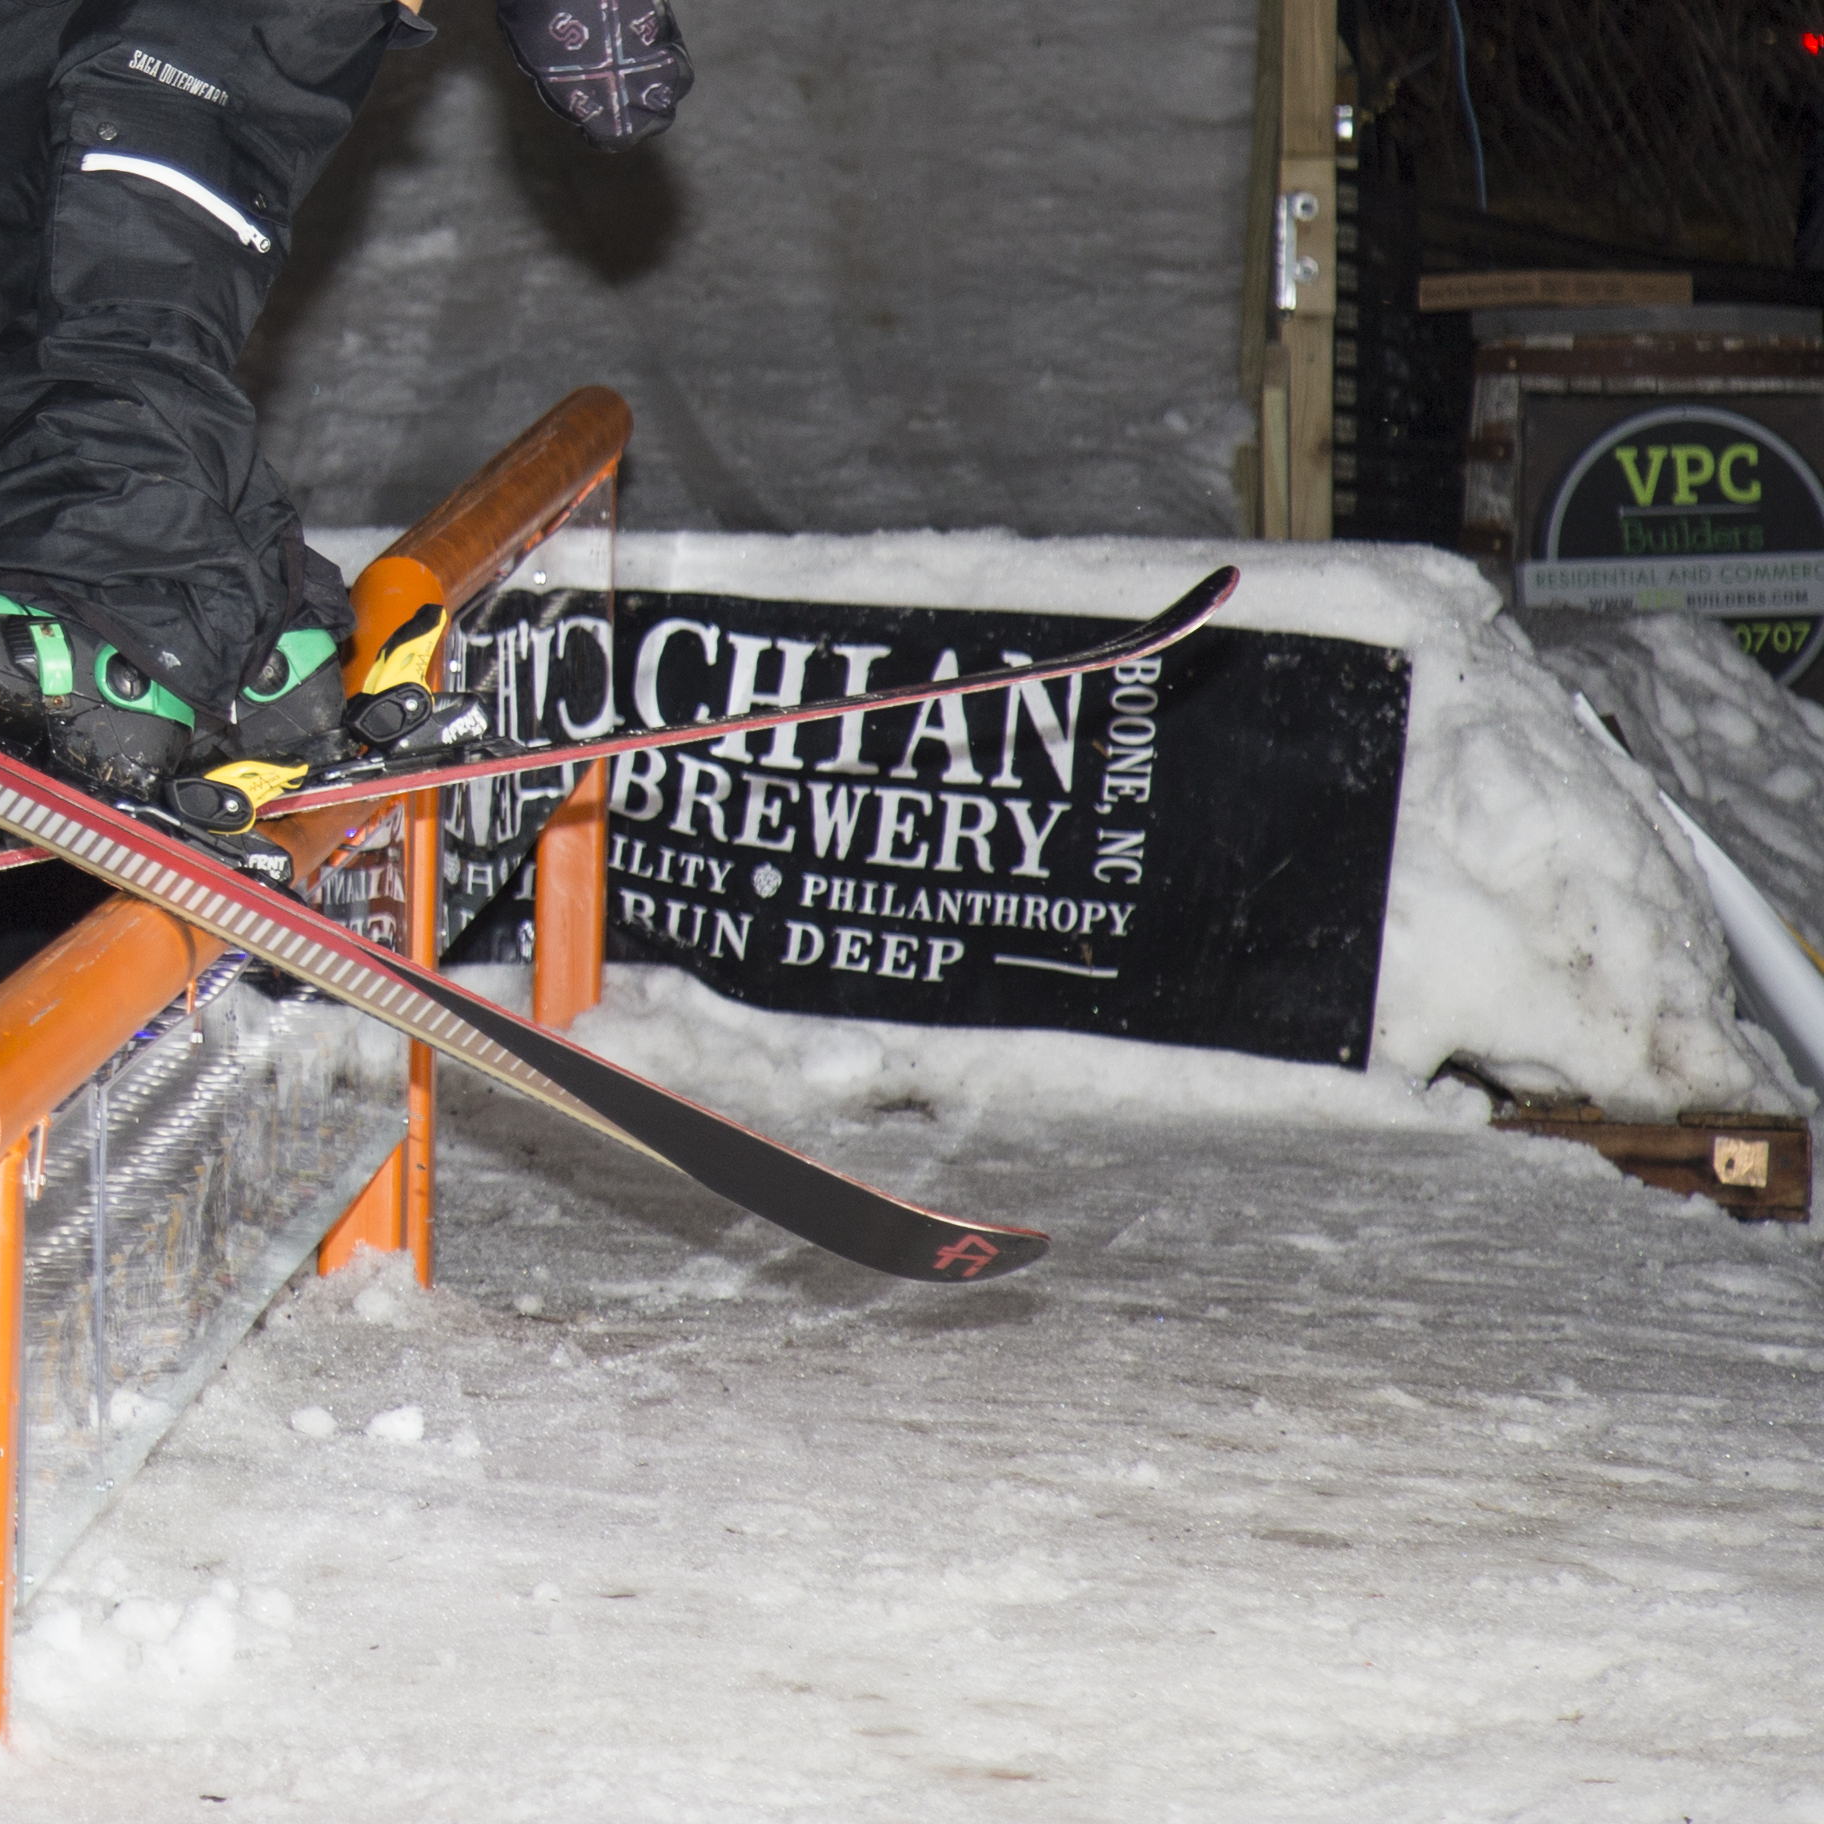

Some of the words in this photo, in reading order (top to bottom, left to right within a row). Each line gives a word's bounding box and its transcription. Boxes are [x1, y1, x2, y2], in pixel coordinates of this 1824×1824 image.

[129, 49, 163, 78] SAGA
[158, 63, 229, 107] OUTERWEAR
[1615, 442, 1762, 507] VPC
[1621, 516, 1765, 555] Builders
[1536, 565, 1655, 590] RESIDENTIAL
[1667, 564, 1712, 586] AND
[1093, 655, 1162, 815] BOONE,
[609, 748, 1071, 878] BREWERY
[1093, 827, 1146, 885] NC
[617, 887, 754, 962] RUN
[781, 919, 965, 982] DEEP
[801, 871, 1137, 937] PHILANTHROPY
